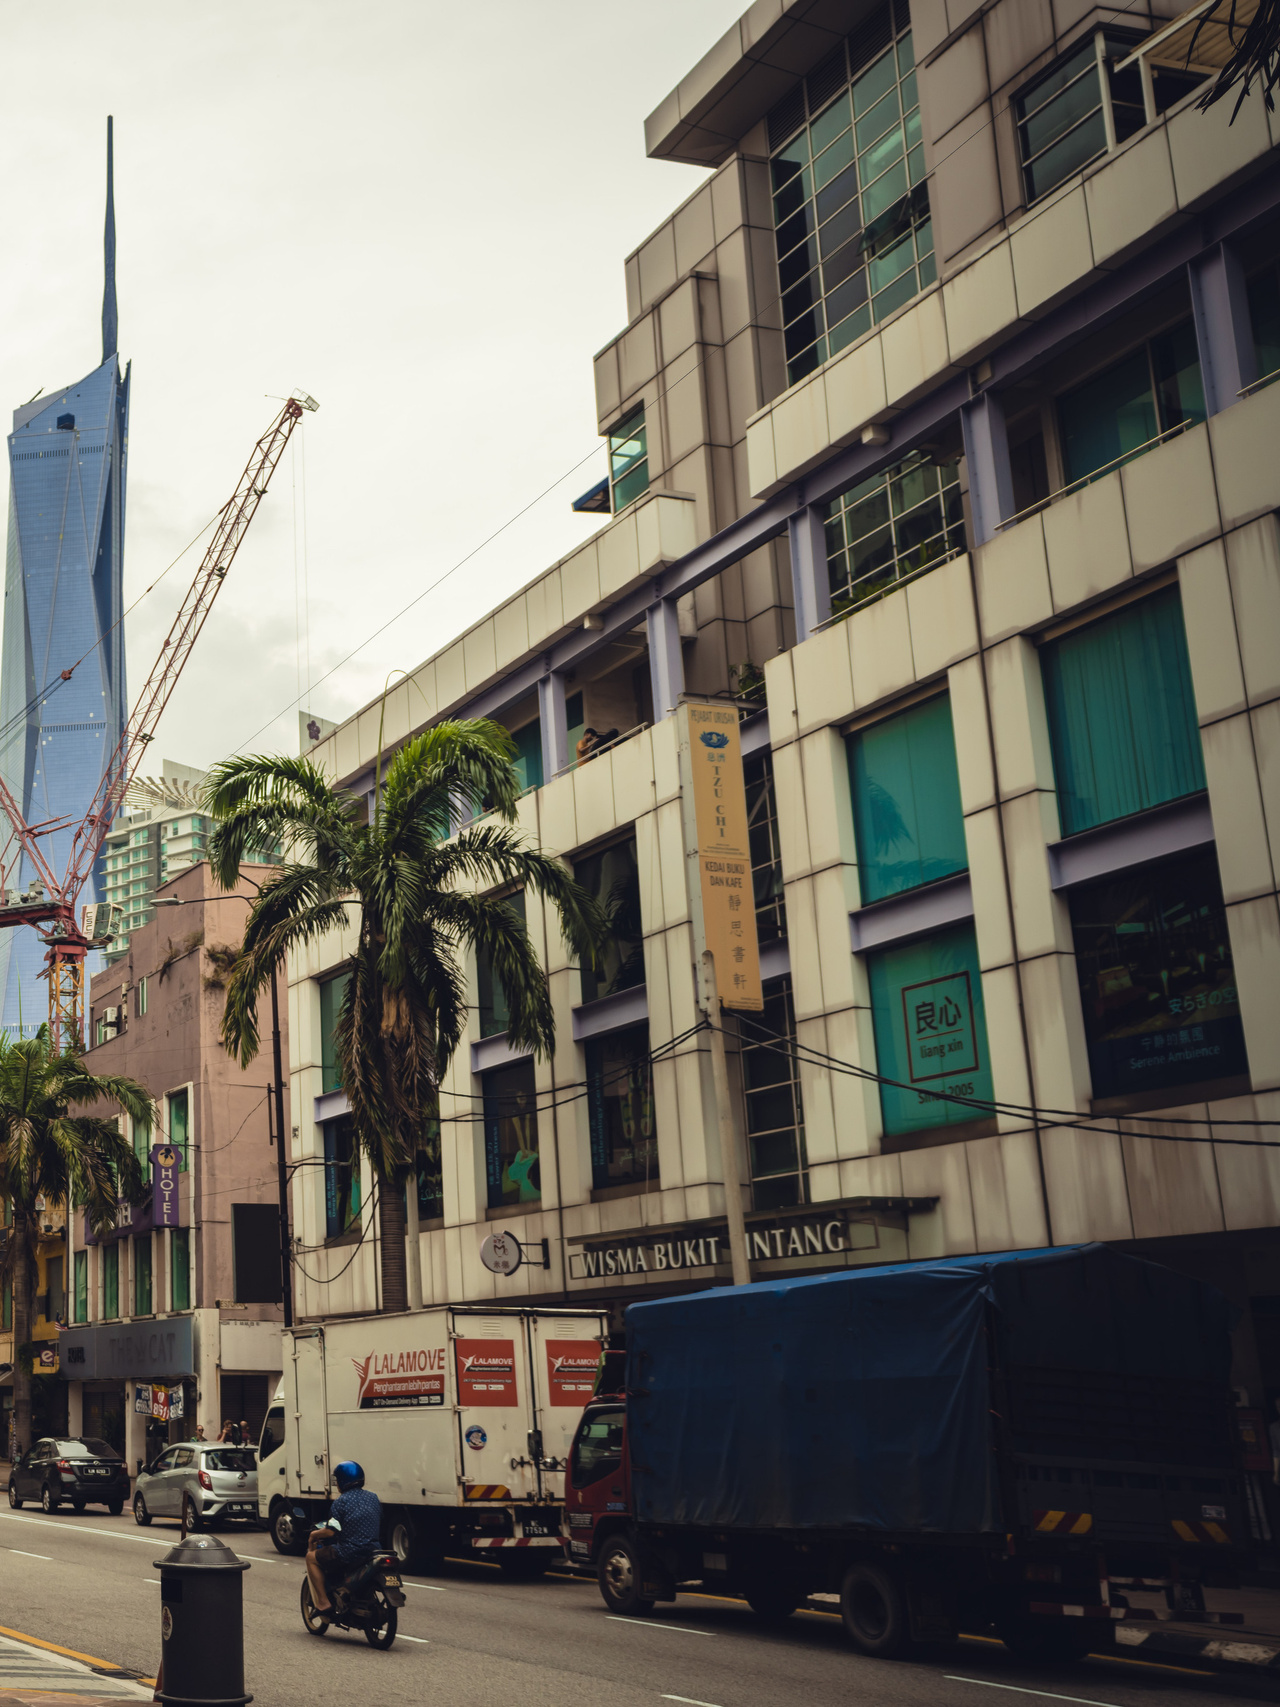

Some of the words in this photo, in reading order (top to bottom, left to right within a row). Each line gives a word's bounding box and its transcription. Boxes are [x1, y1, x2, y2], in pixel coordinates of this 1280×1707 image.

[712, 765, 723, 798] TZU
[715, 804, 726, 838] CHI
[705, 861, 725, 873] KEDAI
[726, 863, 745, 875] BUKU
[709, 875, 725, 887] DAN
[725, 877, 743, 889] KAFE
[915, 996, 962, 1034] 良心
[920, 1044, 946, 1059] liang
[947, 1038, 964, 1053] xin
[1130, 1055, 1166, 1070] Serene
[1168, 1045, 1221, 1063] Ambience
[160, 1168, 174, 1225] HOTEL
[579, 1246, 647, 1278] WISMA
[654, 1236, 720, 1270] BUKIT
[745, 1221, 846, 1260] INTANG
[374, 1348, 446, 1375] LALAMOVE
[473, 1357, 513, 1365] LALAMOVE
[563, 1358, 600, 1366] LALAMOVE
[373, 1381, 408, 1395] Penghantaran
[408, 1379, 421, 1391] lebih
[421, 1379, 440, 1392] pantas
